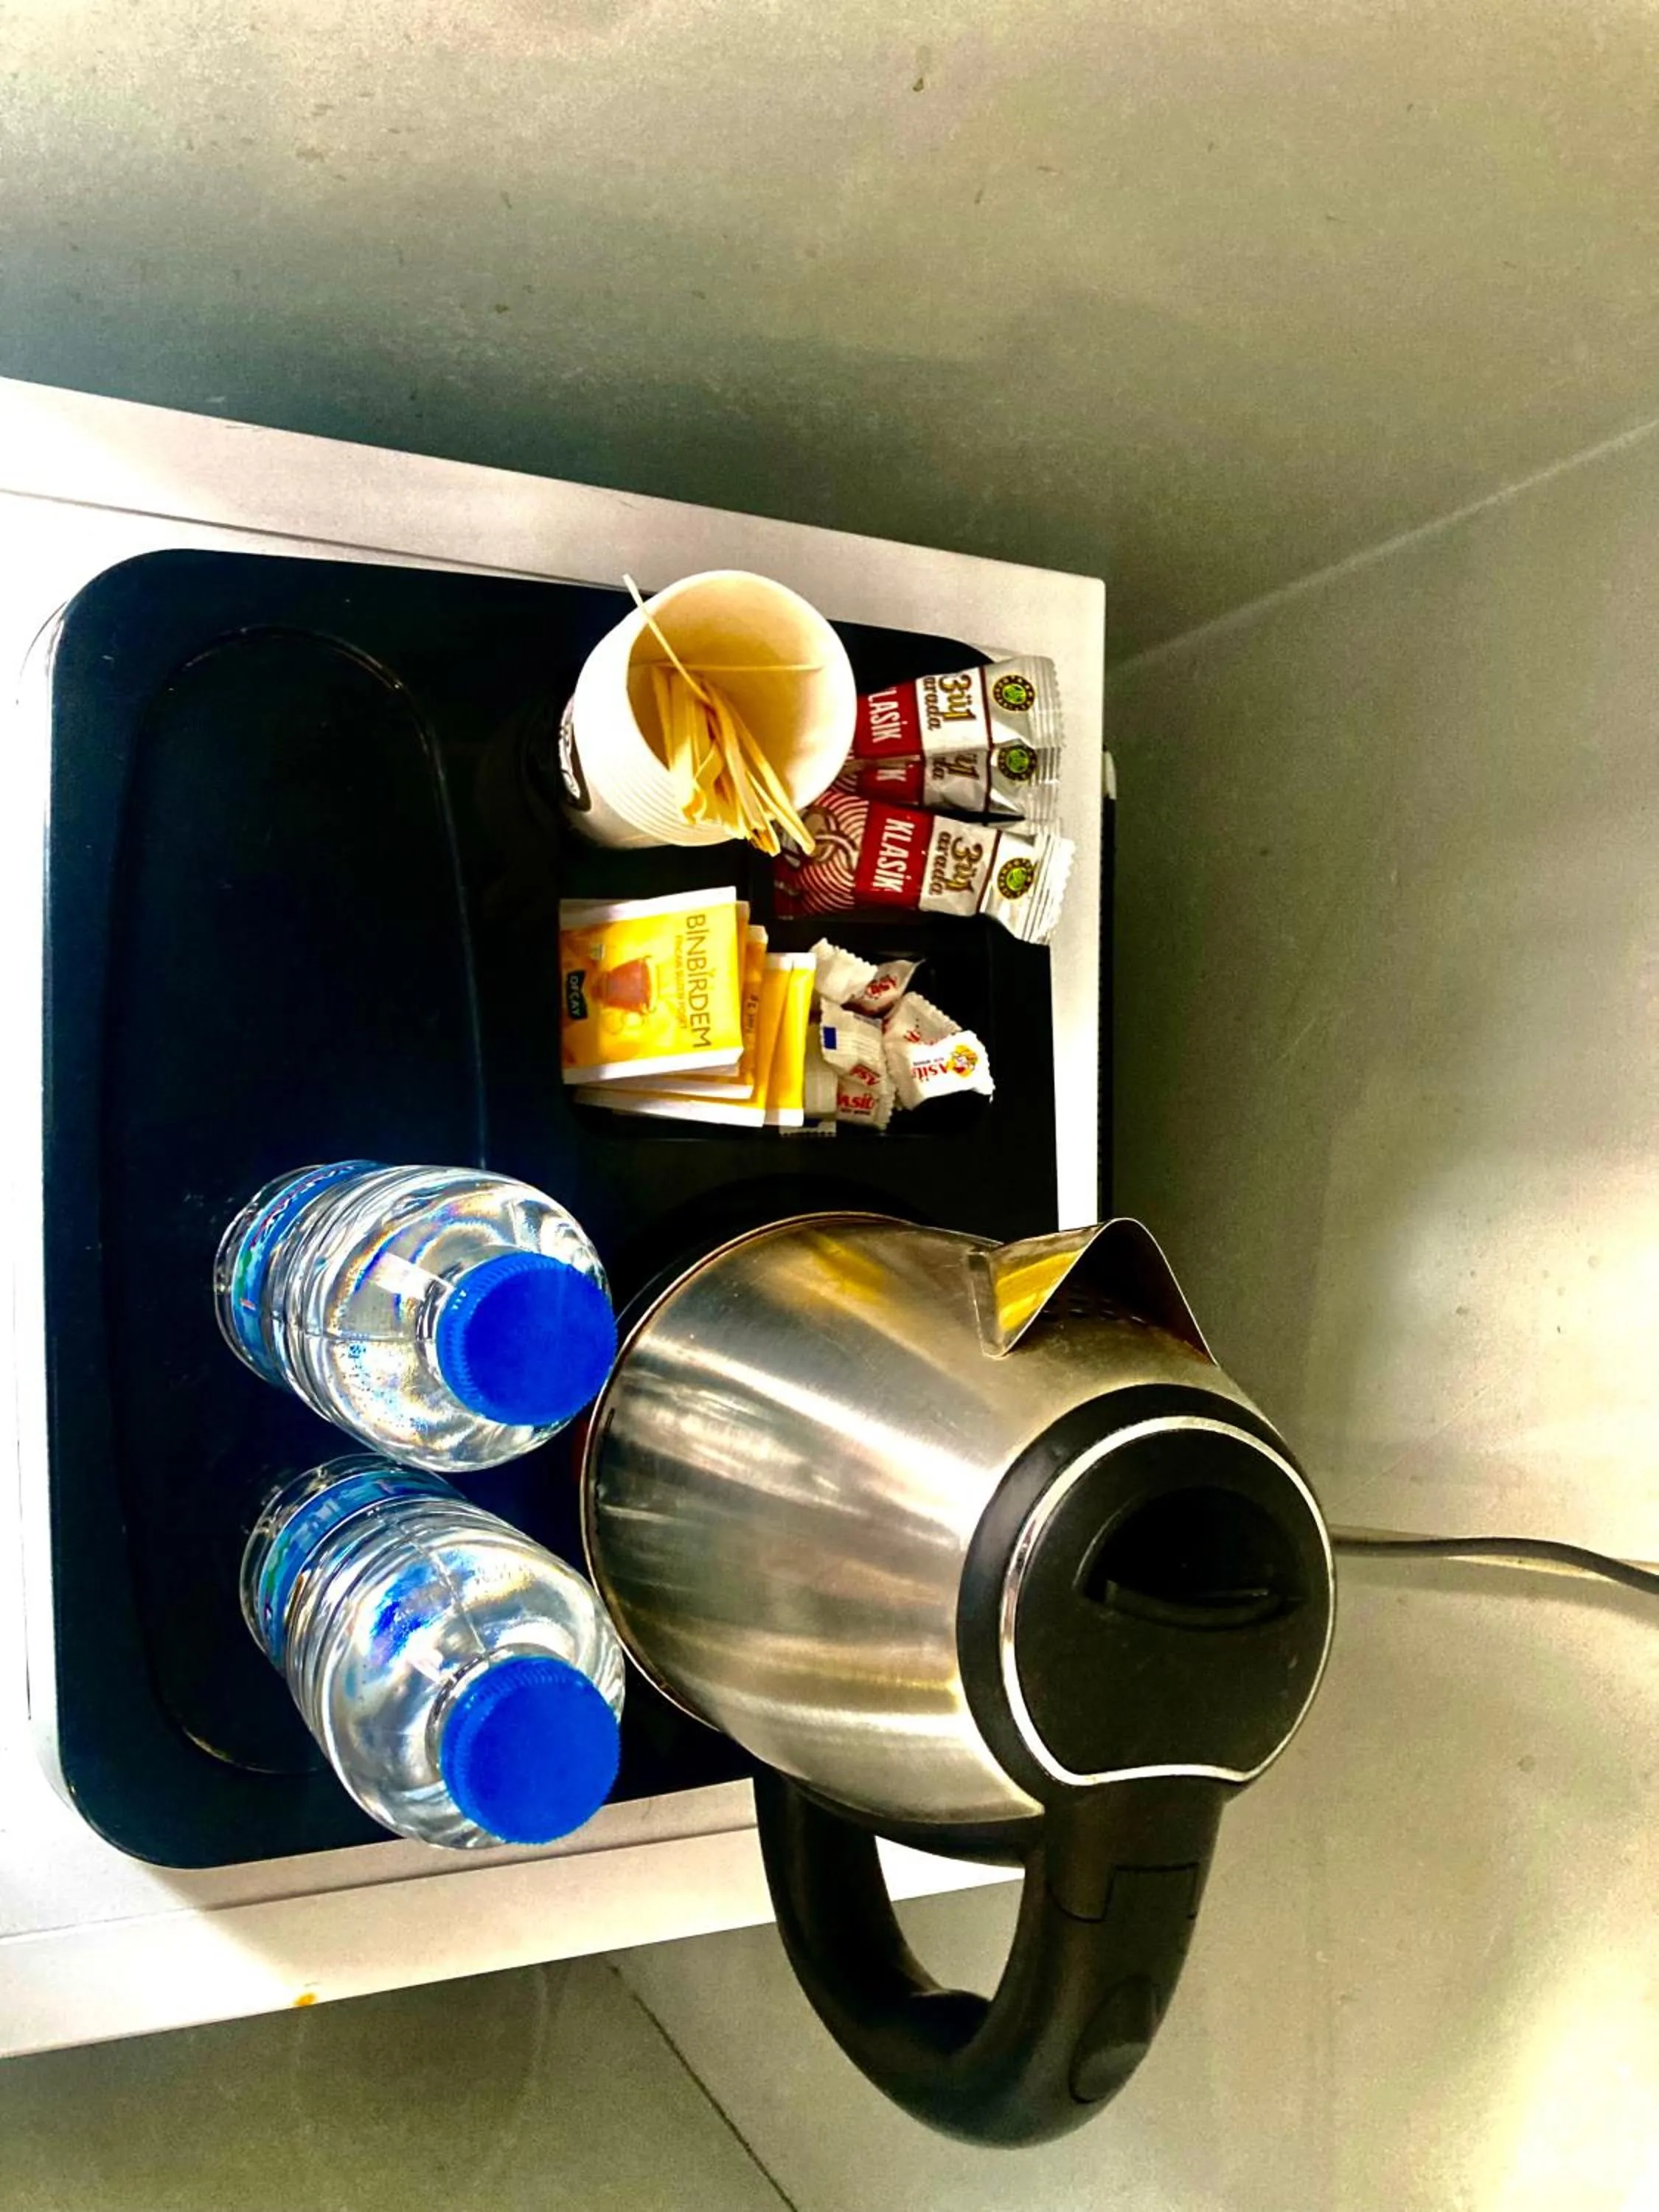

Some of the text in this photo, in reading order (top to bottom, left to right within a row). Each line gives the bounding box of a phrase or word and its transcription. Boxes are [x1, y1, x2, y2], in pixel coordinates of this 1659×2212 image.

[867, 686, 908, 743] LASİK
[872, 818, 915, 894] KLASİK
[929, 831, 952, 896] arada
